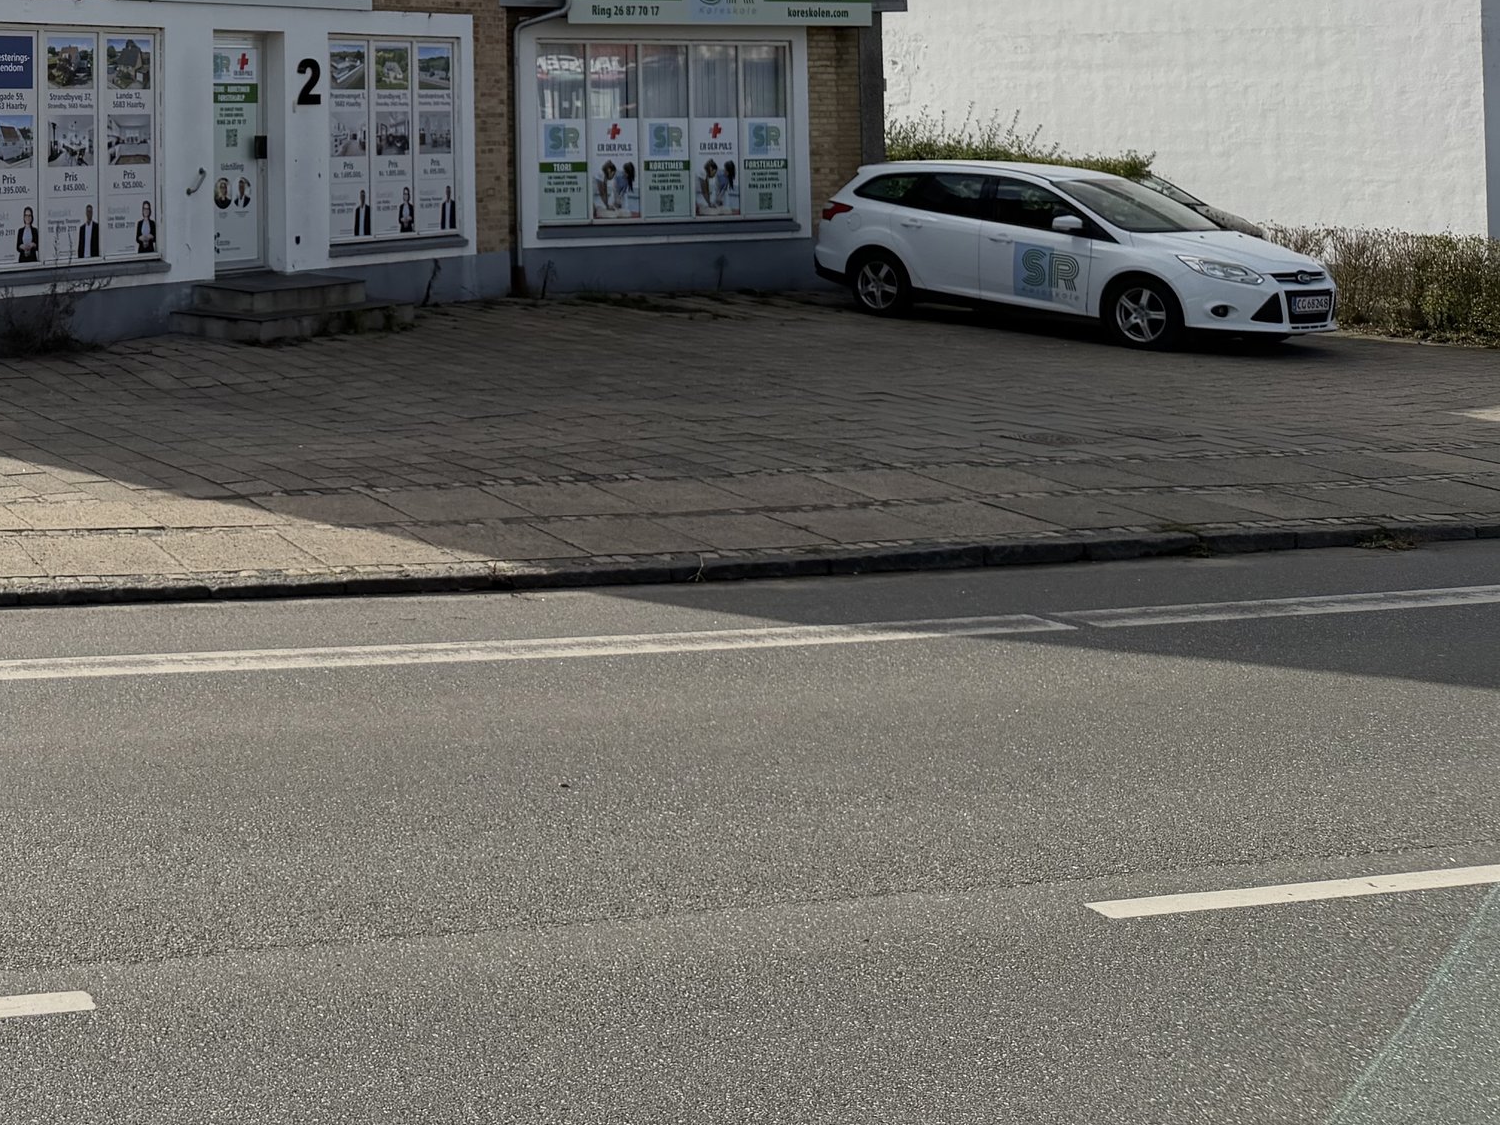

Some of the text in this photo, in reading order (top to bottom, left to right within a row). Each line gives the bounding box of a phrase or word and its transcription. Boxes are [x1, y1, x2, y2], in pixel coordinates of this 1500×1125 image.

[592, 5, 660, 18] Ring 26 87 70 17
[297, 58, 321, 105] 2
[16, 92, 24, 102] 59,
[49, 92, 83, 102] Strandbyvej
[6, 101, 28, 112] Haarby
[112, 100, 145, 110] 5683 Haarby
[549, 127, 579, 150] SR
[653, 126, 683, 149] SR
[752, 125, 781, 147] SR
[597, 143, 632, 152] ER DER PULS
[700, 142, 732, 151] ER DER PULS
[343, 161, 354, 170] Pris
[388, 160, 399, 168] Pris
[431, 158, 441, 166] Pris
[553, 163, 572, 172] TEORI
[2, 174, 16, 185] Pris
[64, 172, 78, 182] Pris
[123, 170, 136, 180] Pris
[53, 184, 62, 192] Kr.
[112, 181, 121, 189] Kr.
[1022, 249, 1079, 291] SR
